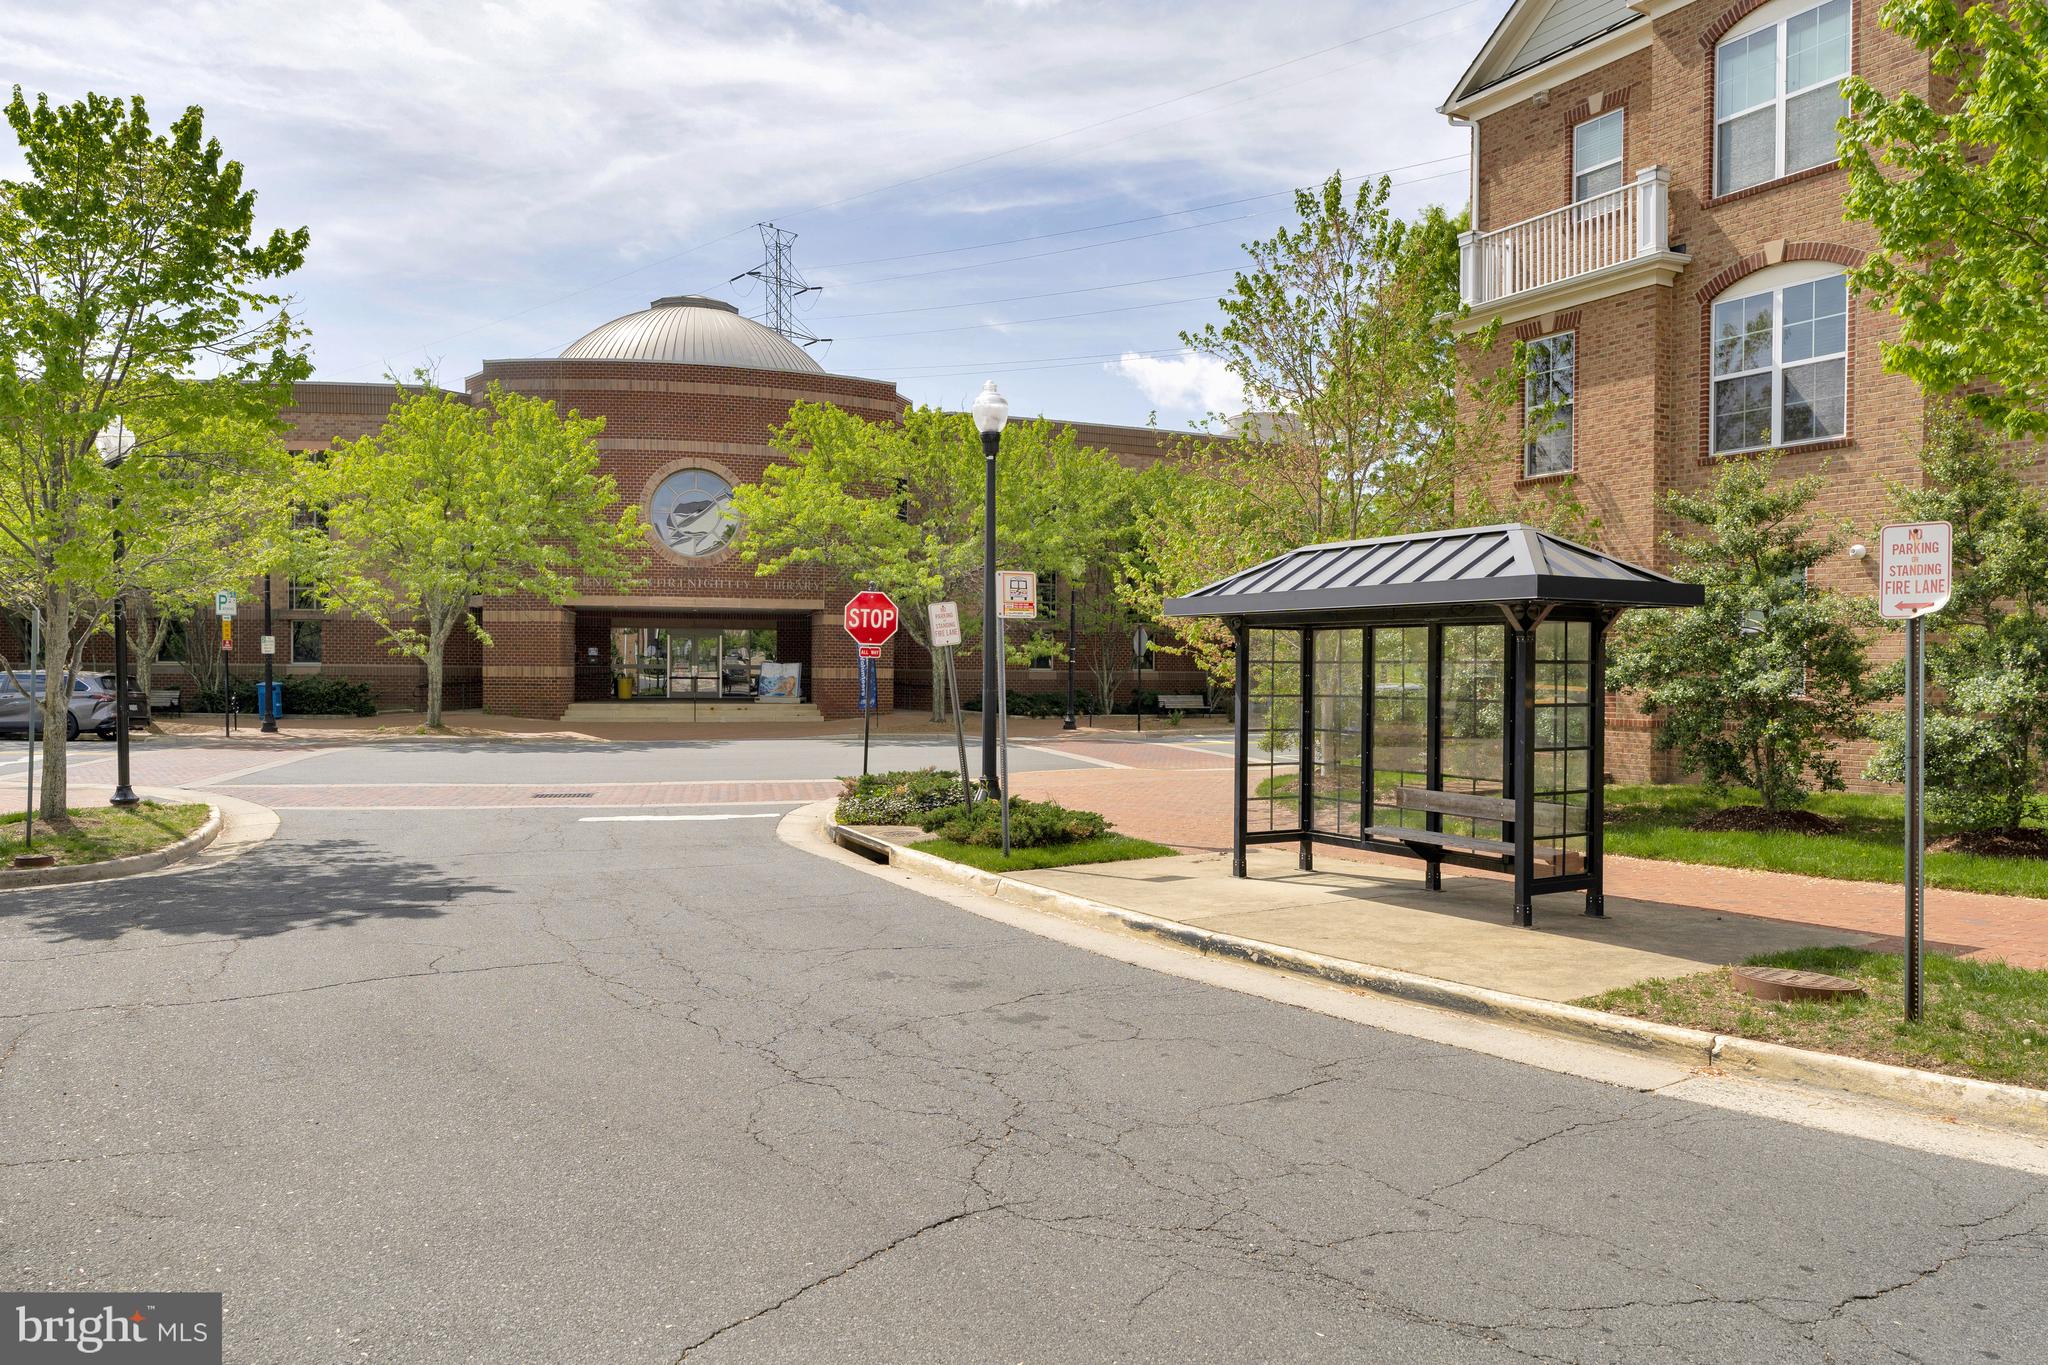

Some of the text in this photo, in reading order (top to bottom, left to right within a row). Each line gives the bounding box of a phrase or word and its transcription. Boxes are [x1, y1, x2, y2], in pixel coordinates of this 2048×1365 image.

[1908, 528, 1923, 540] NO
[1892, 541, 1939, 555] PARKING
[1889, 563, 1942, 577] STANDING
[1885, 579, 1945, 595] FIRE LANE
[219, 595, 227, 610] P
[848, 608, 895, 629] STOP
